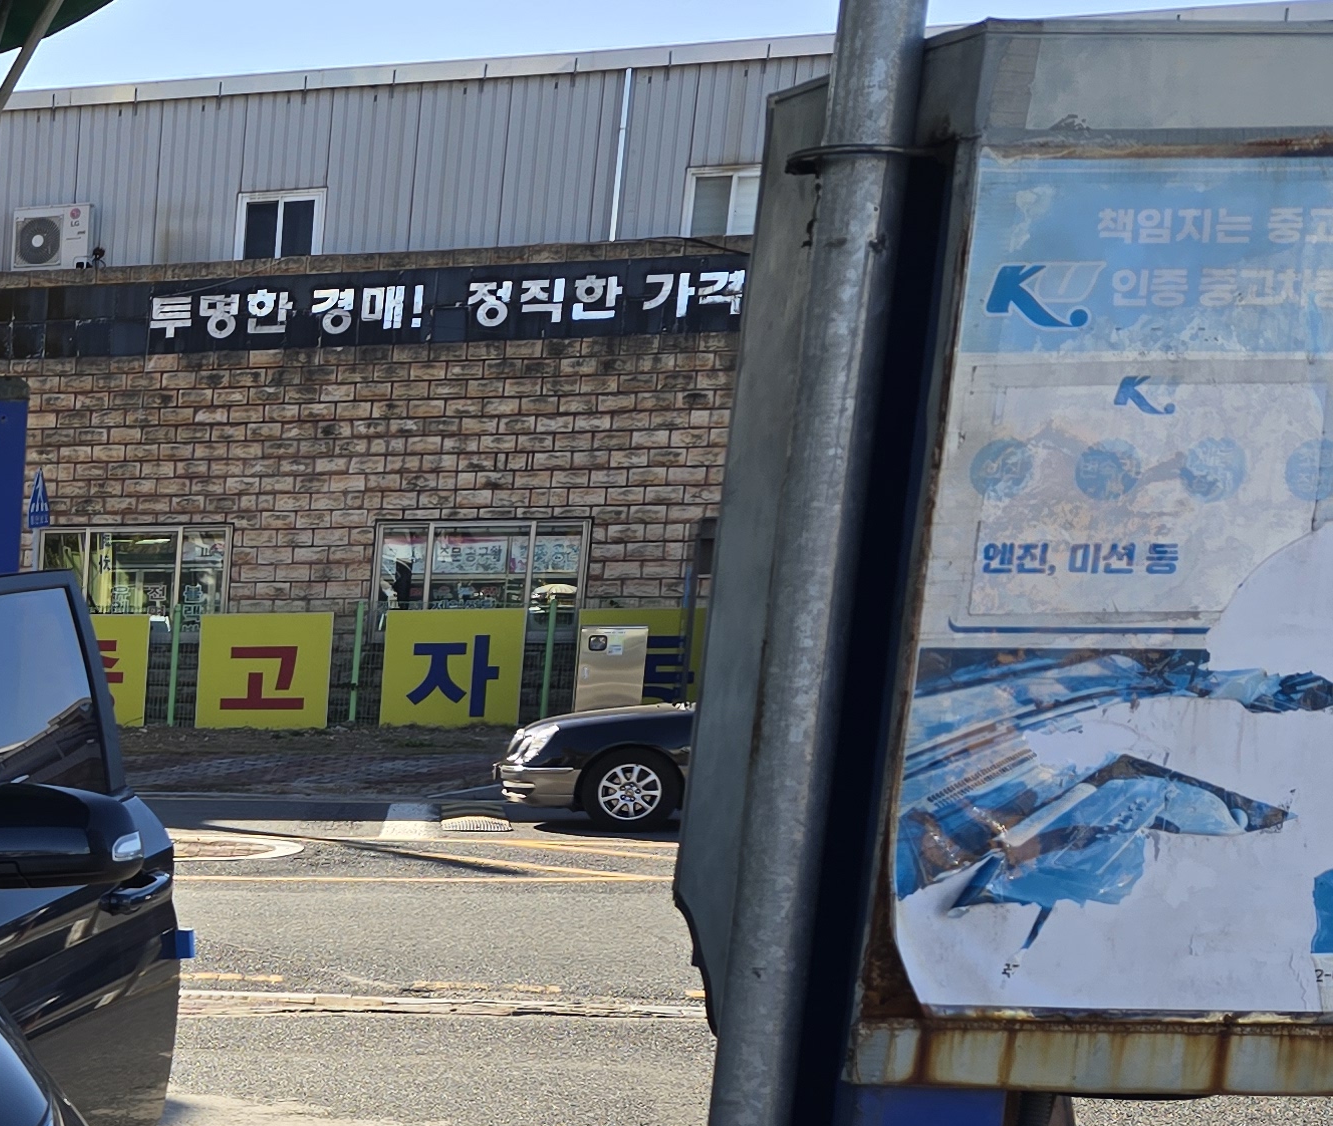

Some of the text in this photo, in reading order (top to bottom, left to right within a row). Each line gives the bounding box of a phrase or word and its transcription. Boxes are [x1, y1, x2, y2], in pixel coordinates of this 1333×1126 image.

[1097, 207, 1253, 244] 책임지는
[149, 288, 295, 338] 투명한
[311, 283, 424, 335] 경매!
[467, 274, 623, 327] 정직한
[1111, 268, 1189, 307] 인증
[981, 541, 1179, 576] 엔진, 미션 등
